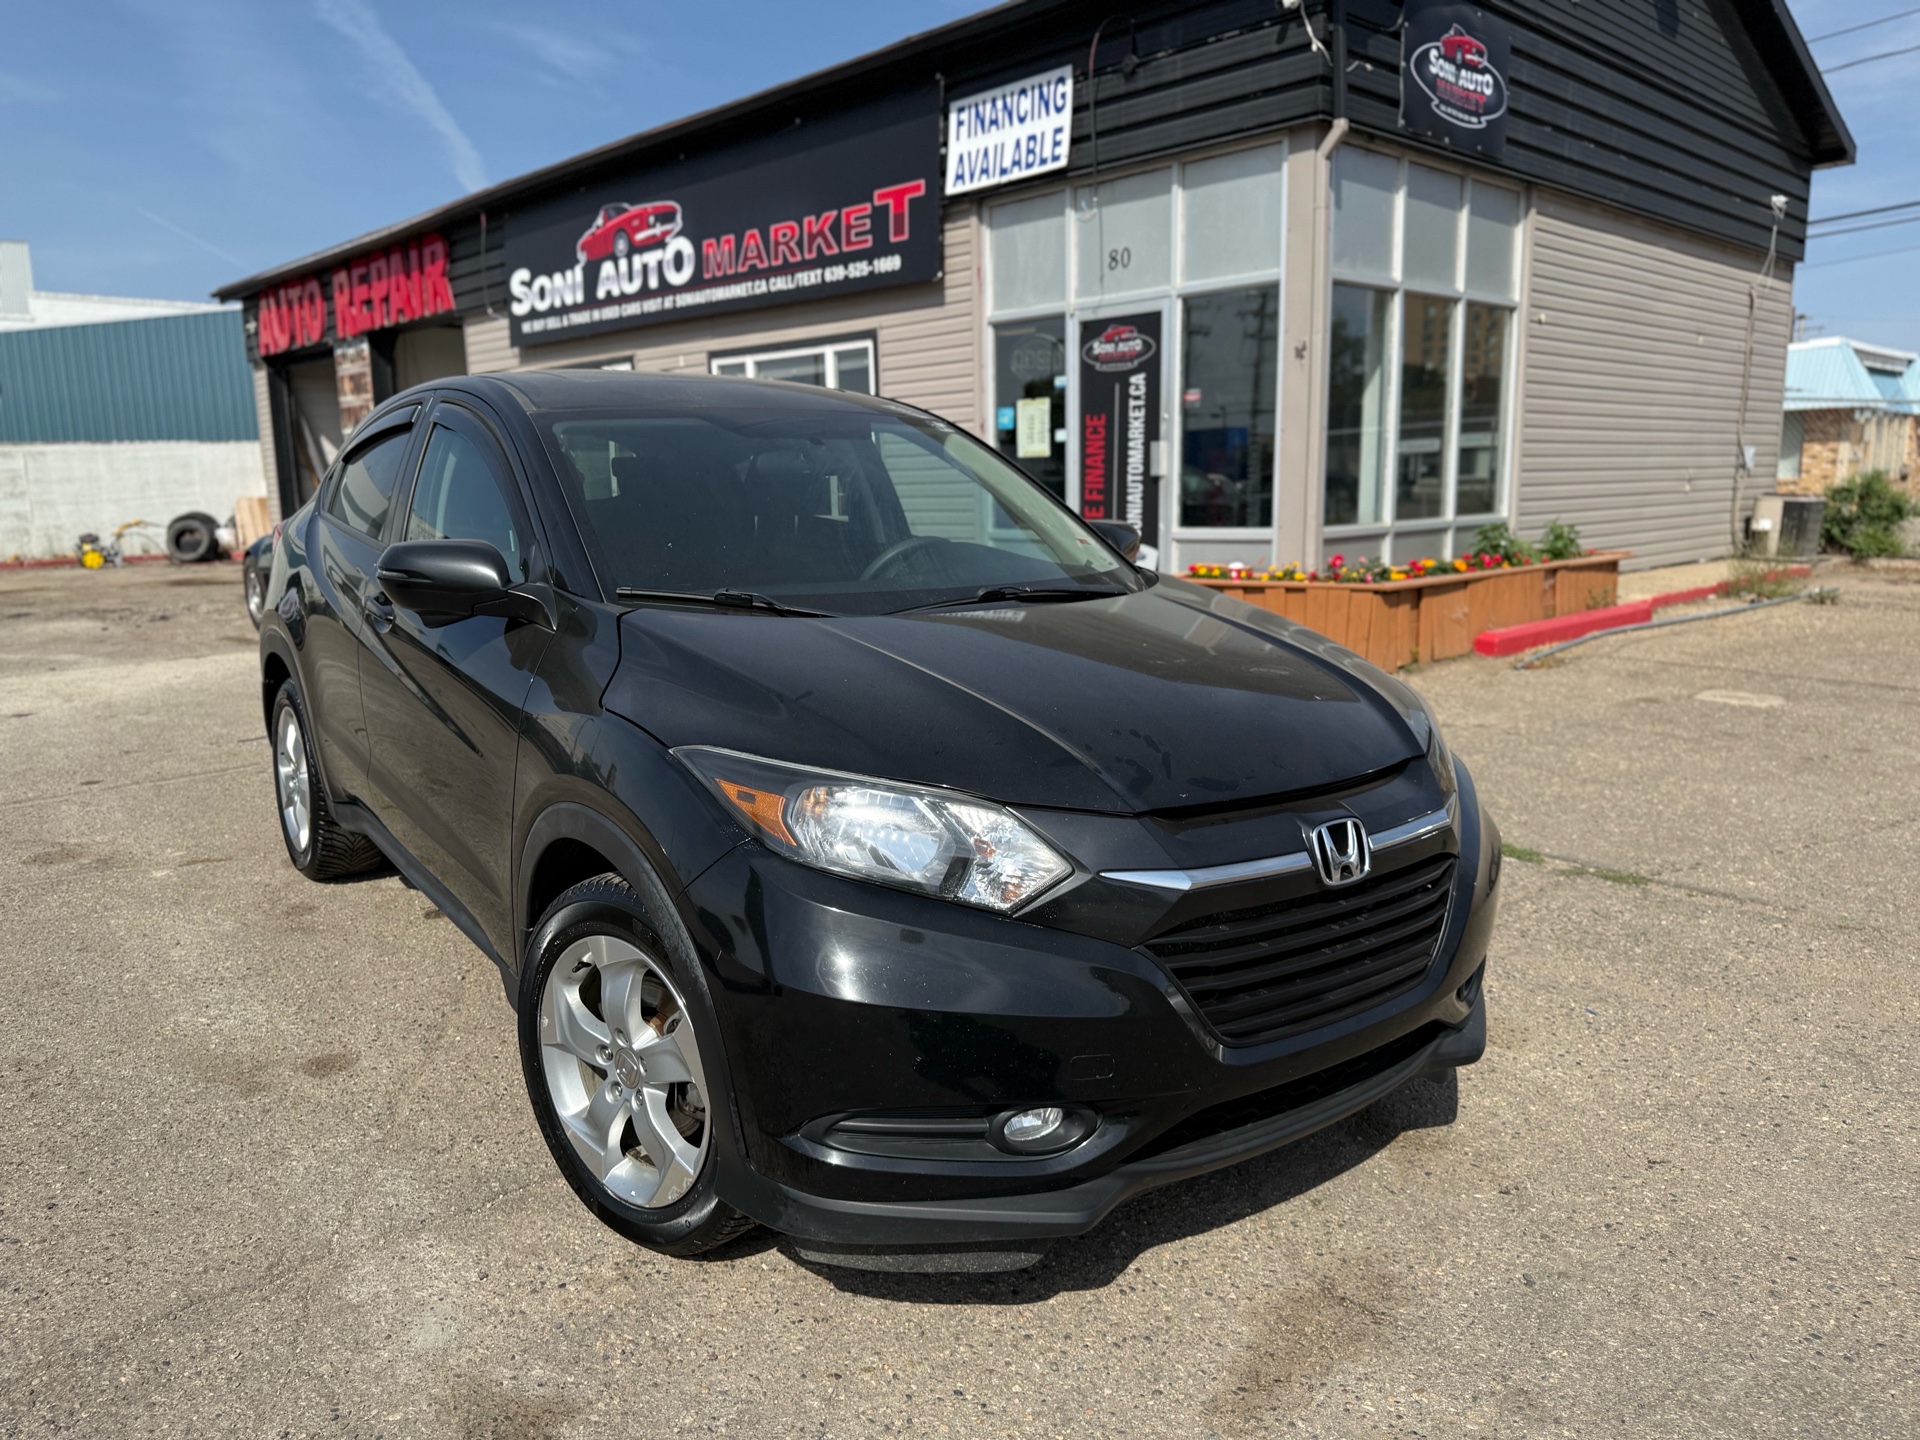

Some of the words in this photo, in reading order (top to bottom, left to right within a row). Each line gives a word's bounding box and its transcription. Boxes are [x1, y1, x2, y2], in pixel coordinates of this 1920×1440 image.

[956, 75, 1067, 142] FINANCING
[1458, 68, 1494, 96] AUTO
[953, 126, 1065, 188] AVAILABLE
[510, 265, 584, 317] SONI
[596, 235, 696, 300] AUTO
[702, 178, 926, 279] MARKET
[1108, 246, 1131, 271] 80
[257, 274, 327, 357] AUTO
[331, 233, 456, 338] REPAIR
[768, 267, 823, 293] CALL/TEXT
[1084, 413, 1106, 501] FINANCE
